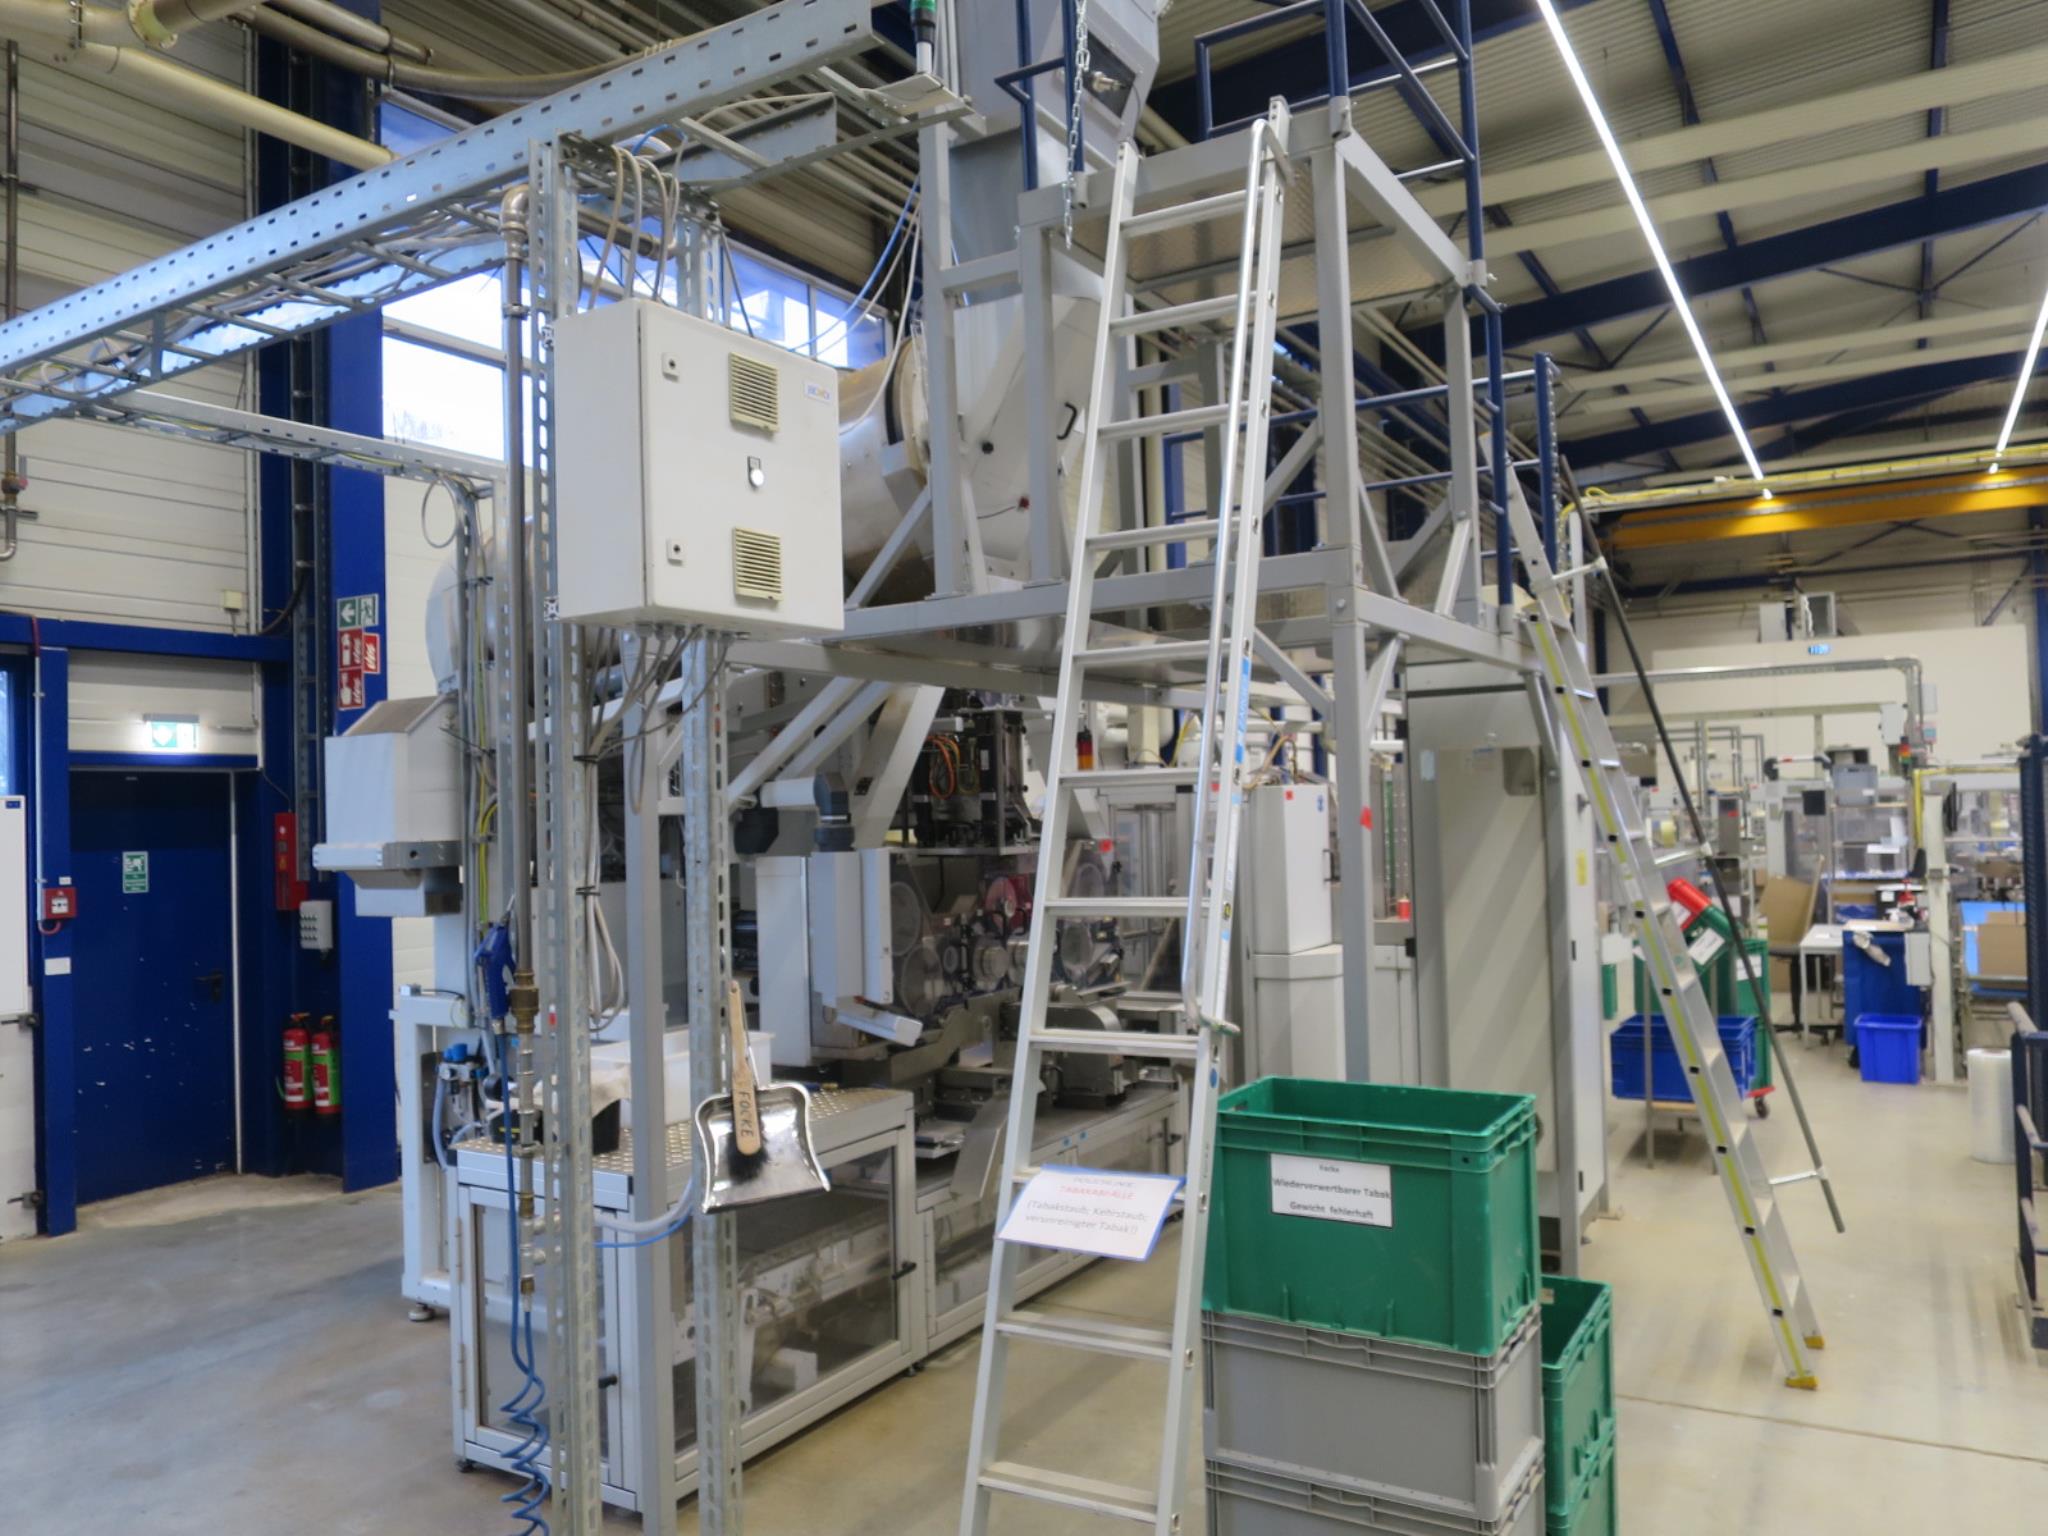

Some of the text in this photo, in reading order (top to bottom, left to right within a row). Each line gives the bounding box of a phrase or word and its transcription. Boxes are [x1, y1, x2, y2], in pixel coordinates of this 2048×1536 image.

[739, 1091, 753, 1136] FOCKE
[1273, 1178, 1391, 1200] Wiederverwertbarer Tabak
[1289, 1201, 1374, 1219] Gewicht fehlerhaft
